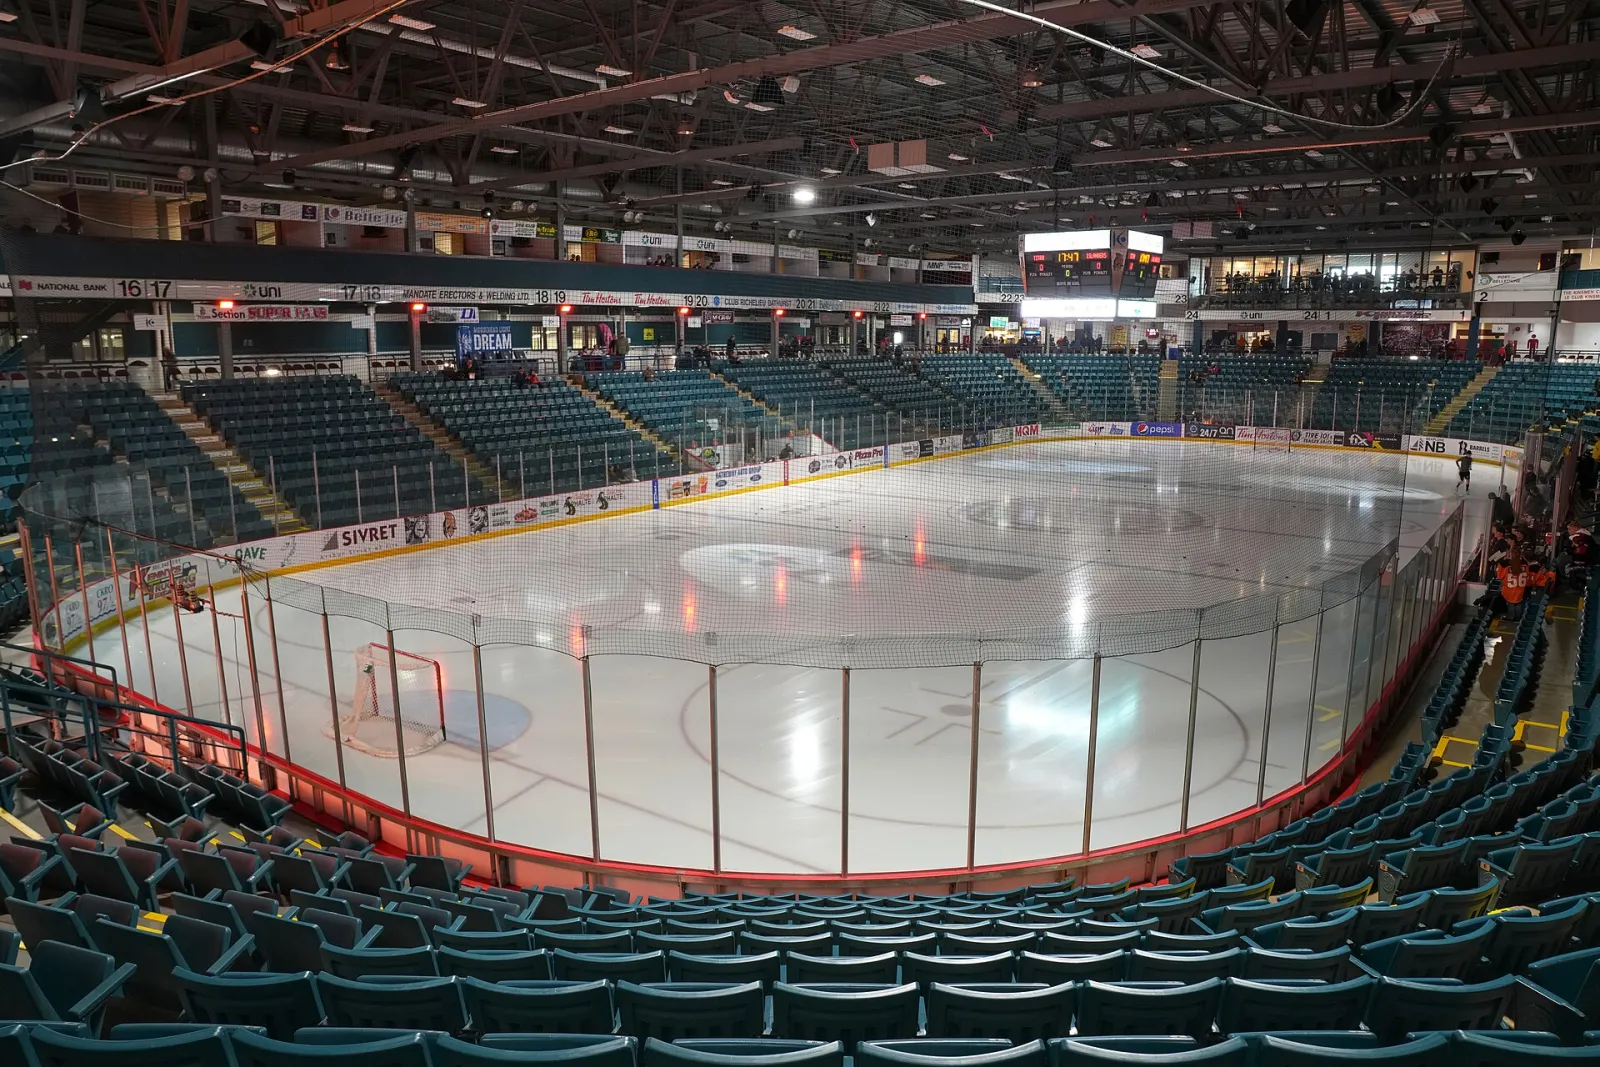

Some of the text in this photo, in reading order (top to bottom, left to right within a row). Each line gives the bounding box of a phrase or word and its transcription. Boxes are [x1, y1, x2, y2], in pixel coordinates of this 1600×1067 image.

[1058, 252, 1079, 262] 17:47
[37, 283, 107, 292] NATIONAL BANK
[118, 280, 141, 297] 16
[150, 281, 171, 298] 17
[341, 286, 357, 300] 17
[364, 286, 381, 300] 18
[402, 290, 436, 299] MANDATE
[439, 290, 476, 300] ERECTORS
[478, 291, 484, 300] &
[486, 291, 515, 300] WELDING
[536, 291, 549, 303] 18
[554, 291, 566, 304] 19
[582, 292, 621, 304] Tim Hortons
[634, 293, 670, 305] Tim Hortons
[684, 295, 693, 306] 19
[696, 295, 708, 306] 20
[1001, 293, 1013, 303] 22
[1014, 294, 1025, 303] 23
[1175, 294, 1187, 303] 23
[1480, 291, 1488, 302] 2
[796, 298, 806, 308] 20
[808, 299, 816, 309] 21
[874, 302, 880, 312] 21
[881, 302, 889, 312] 22
[211, 309, 246, 320] Section
[248, 306, 292, 319] SUPER
[1186, 311, 1199, 320] 24
[1304, 311, 1318, 320] 24
[1326, 311, 1330, 320] 1
[1460, 310, 1465, 320] 1
[473, 333, 512, 350] DREAM
[1014, 424, 1039, 437] MQM
[1149, 425, 1174, 434] pepsi
[1199, 428, 1218, 438] 24/7
[1237, 427, 1288, 440] Tim Hortons
[1424, 440, 1446, 453] NB
[1469, 444, 1490, 453] BARRELS
[854, 450, 872, 460] Pizza
[872, 448, 884, 459] Pro
[341, 523, 398, 547] SIVRET
[1507, 572, 1527, 588] 56
